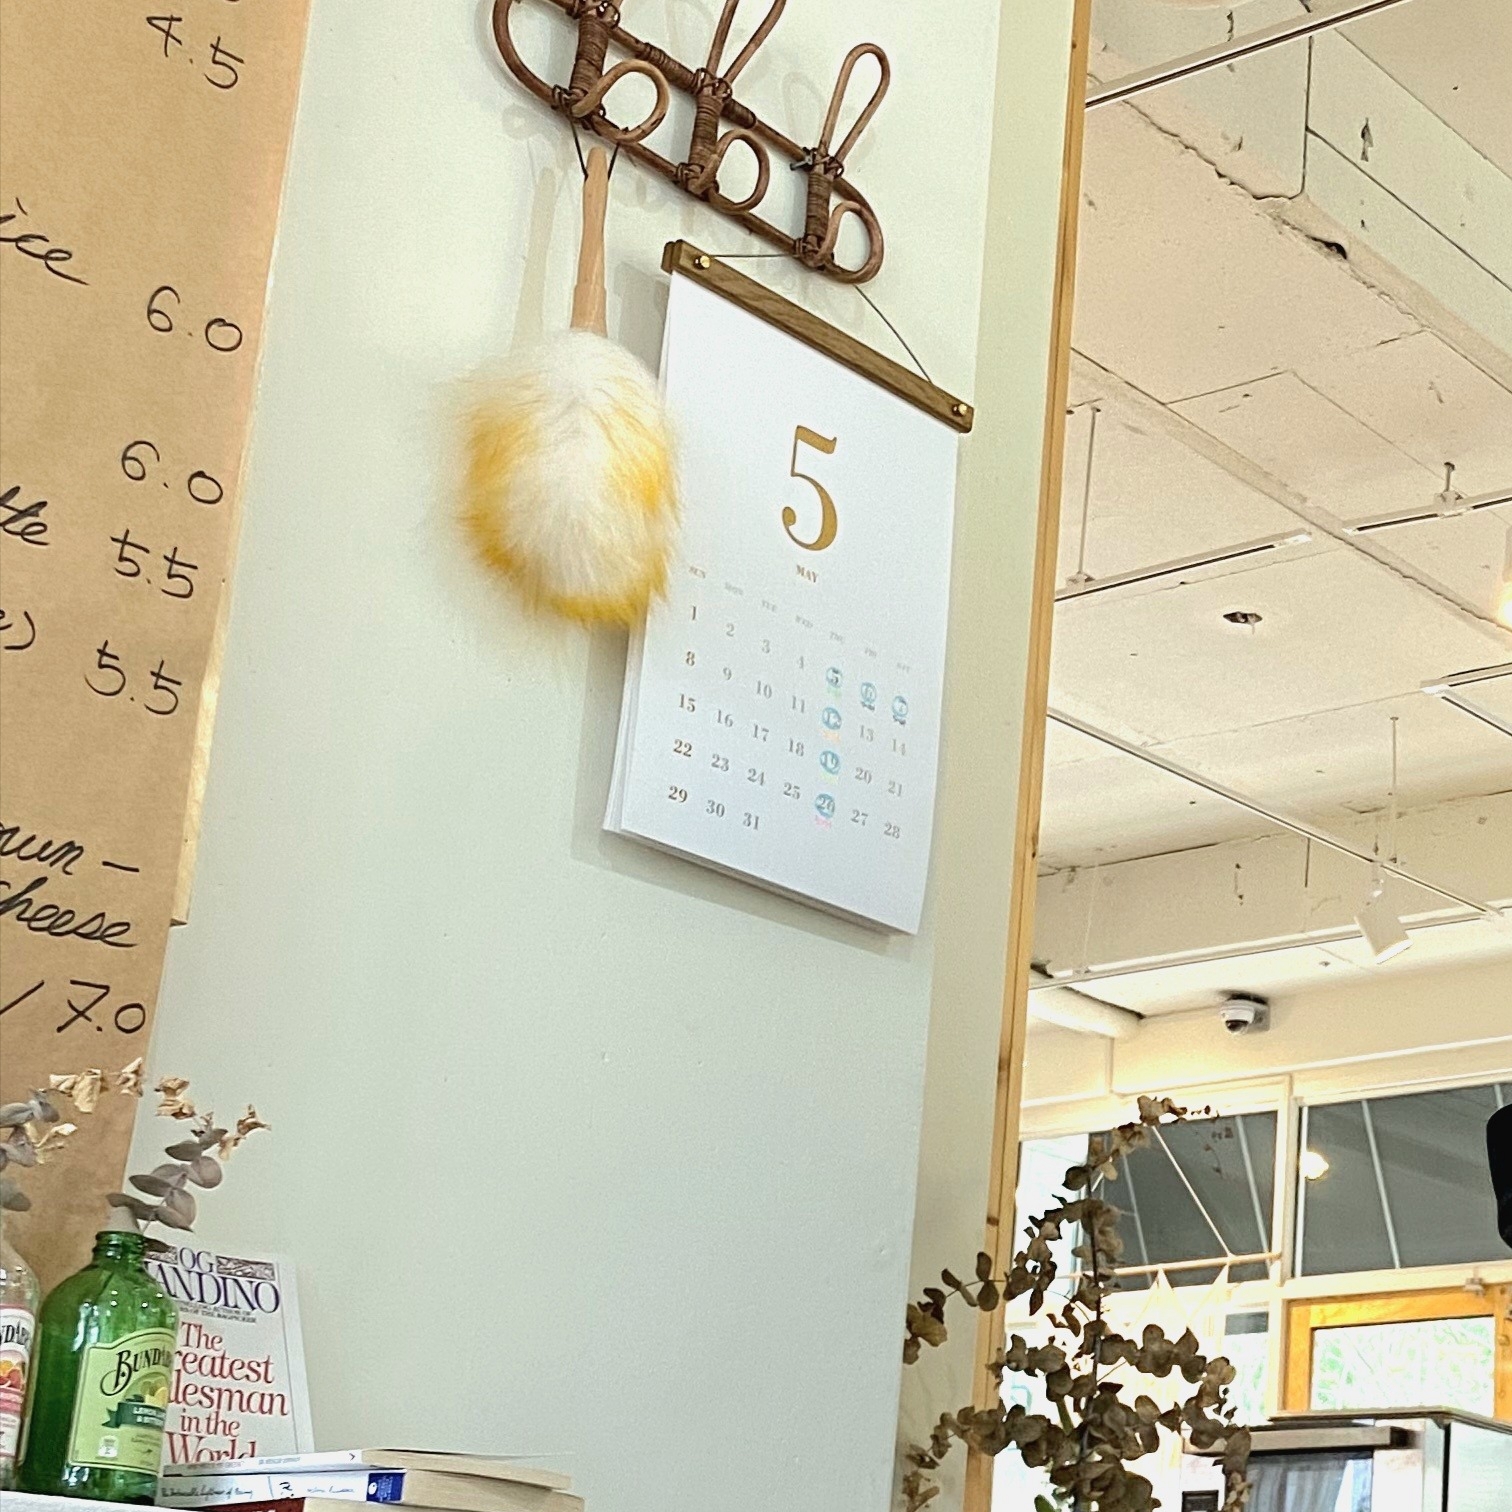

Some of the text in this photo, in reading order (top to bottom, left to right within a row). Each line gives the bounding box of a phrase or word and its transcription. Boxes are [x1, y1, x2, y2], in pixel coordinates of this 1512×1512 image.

[146, 14, 244, 89] 4.5
[147, 286, 243, 352] 6.0
[121, 440, 223, 504] 6.0
[782, 425, 838, 551] 5
[110, 528, 198, 599] 5.5
[796, 565, 818, 583] MAY
[691, 605, 697, 621] 1
[725, 623, 735, 638] 2
[762, 639, 770, 654] 3
[85, 640, 182, 715] 5.5
[685, 651, 695, 667] 8
[722, 667, 732, 682] 9
[756, 680, 772, 699] 10
[790, 696, 806, 714] 11
[860, 725, 875, 743] 13
[891, 738, 906, 757] 14
[678, 693, 696, 713] 15
[716, 709, 734, 728] 16
[752, 724, 769, 744] 17
[787, 738, 804, 757] 18
[855, 767, 872, 785] 20
[887, 780, 903, 797] 21
[668, 786, 760, 830] 29 30 31
[673, 738, 693, 758] 22
[711, 753, 729, 772] 23
[747, 768, 766, 787] 24
[783, 782, 800, 801] 25
[851, 808, 868, 827] 27
[884, 822, 901, 840] 28
[144, 1260, 281, 1314] ANDINO
[180, 1247, 214, 1274] OG
[182, 1322, 223, 1351] The
[180, 1408, 201, 1434] in
[205, 1411, 241, 1438] the
